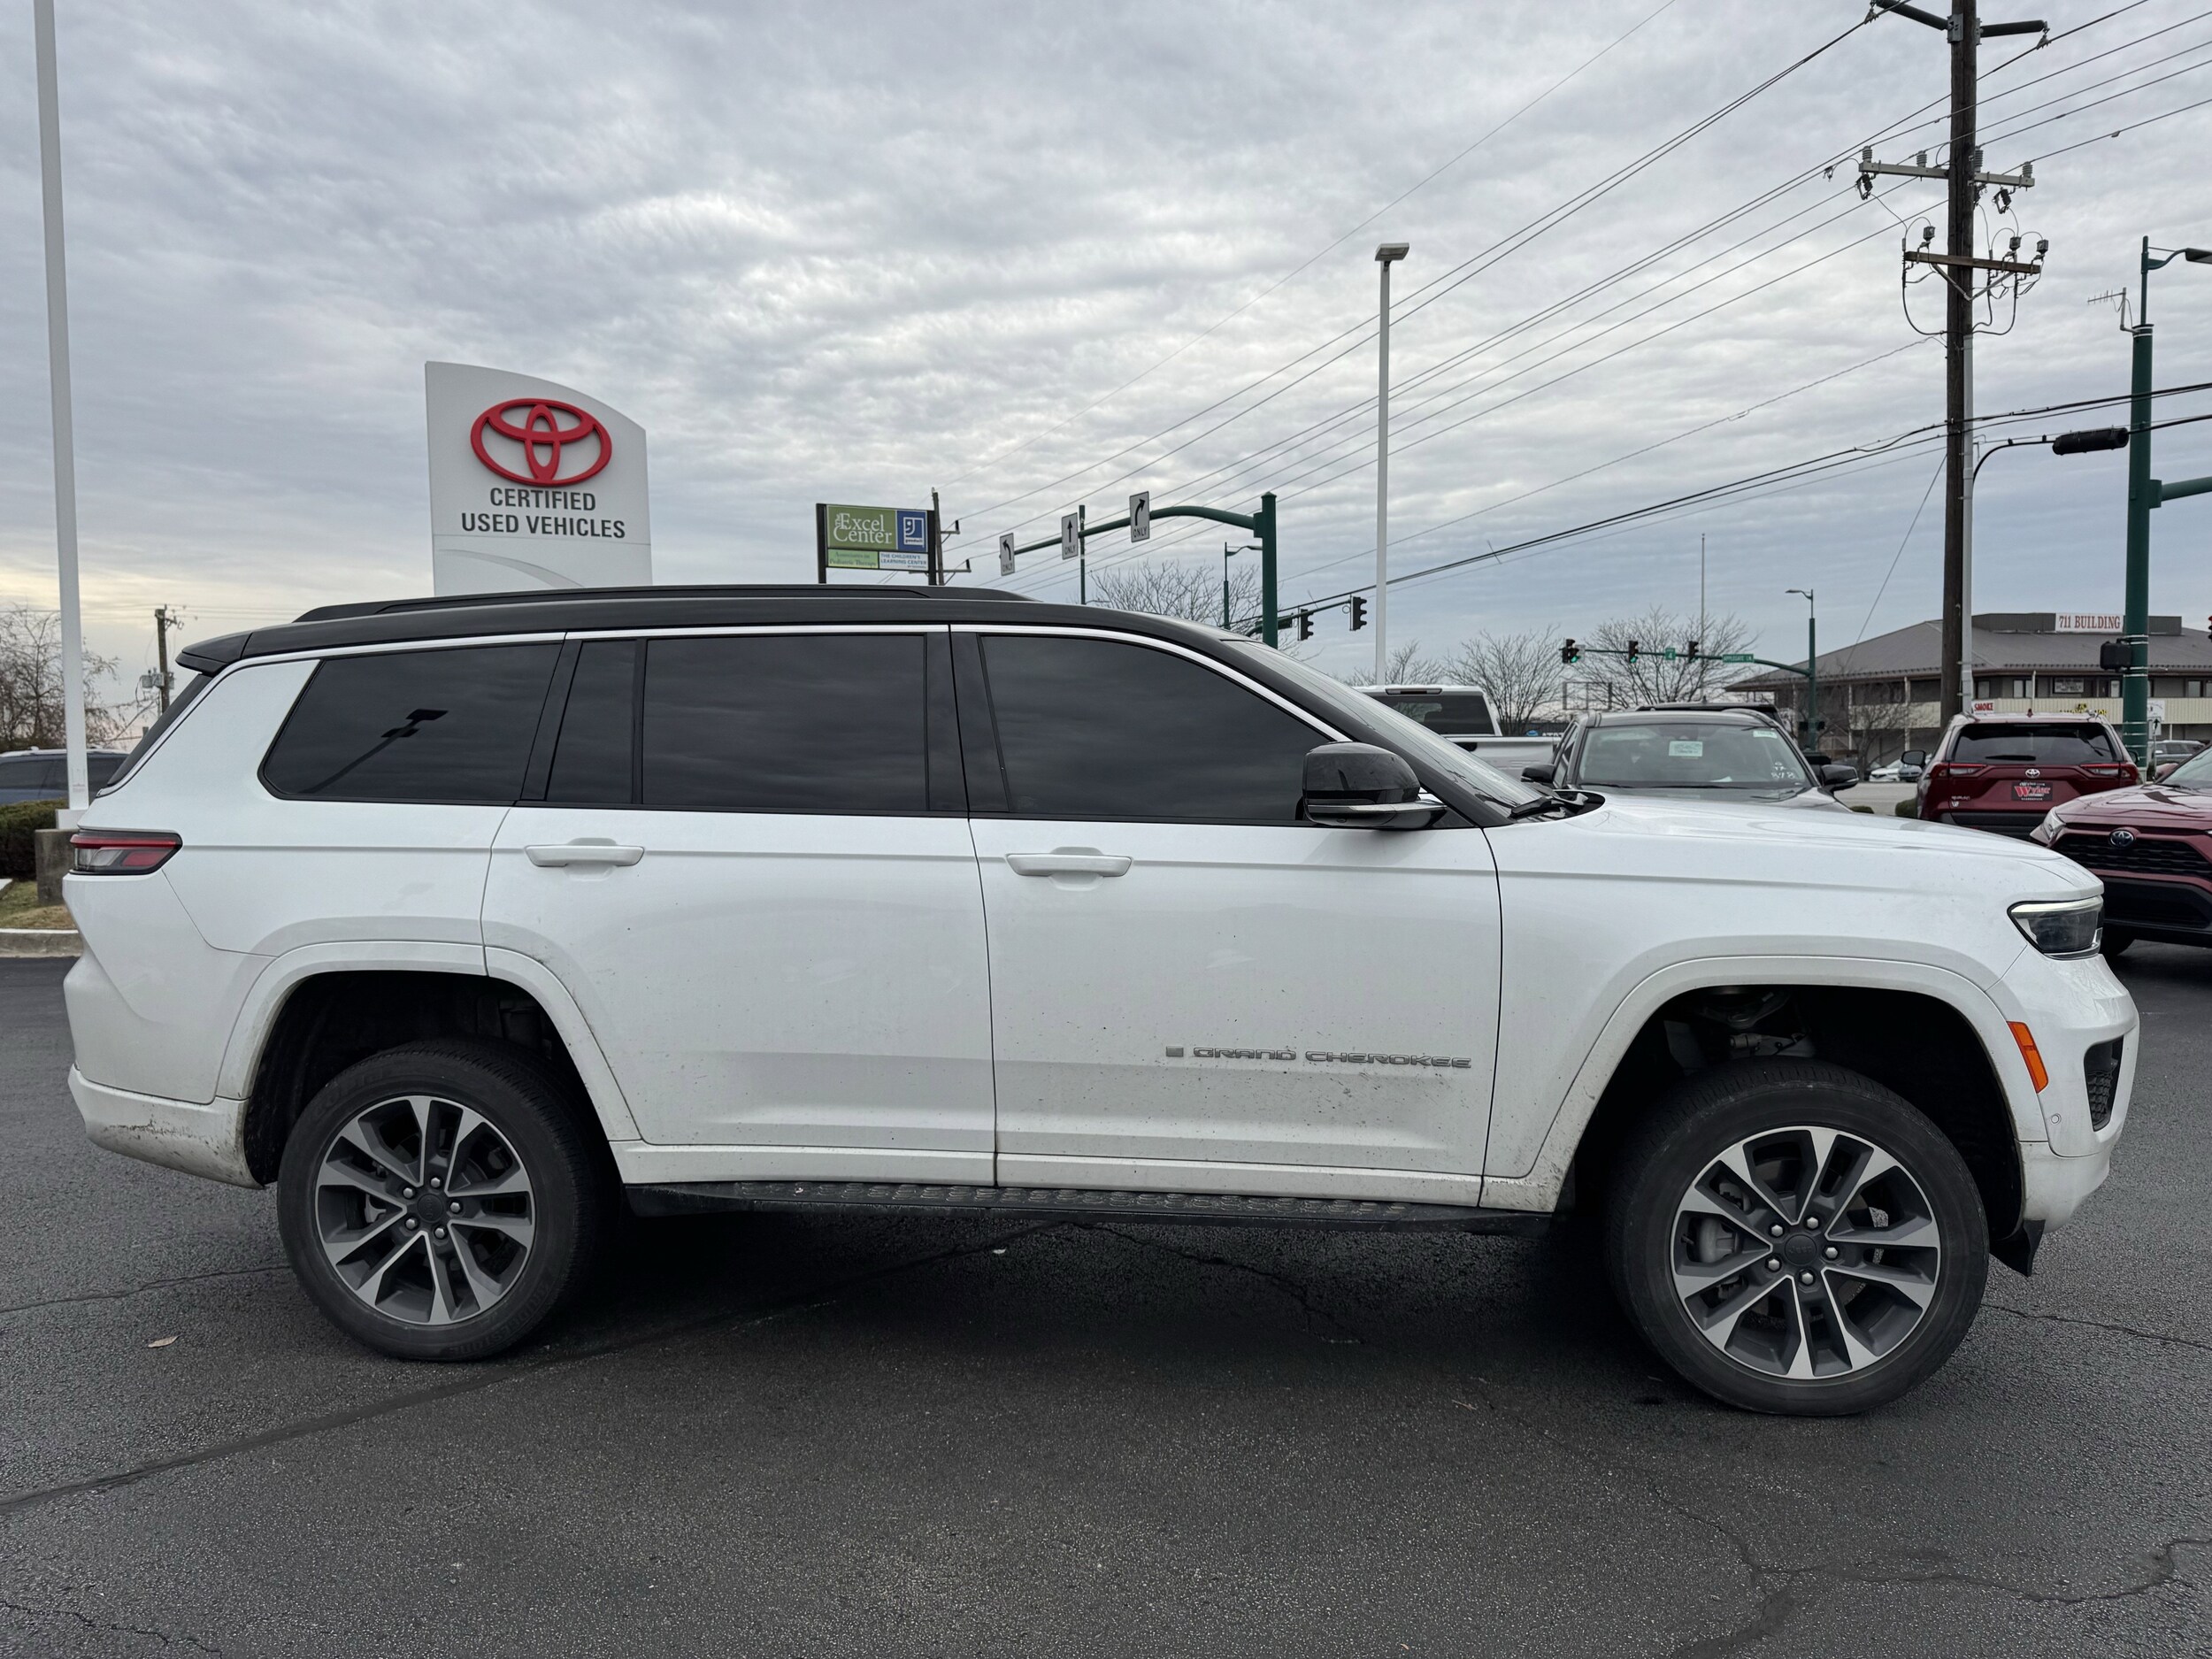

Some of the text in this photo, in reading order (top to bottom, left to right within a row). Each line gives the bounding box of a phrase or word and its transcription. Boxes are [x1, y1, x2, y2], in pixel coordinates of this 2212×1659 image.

[490, 488, 596, 511] CERTIFIED
[461, 512, 626, 539] USED VEHICLES
[839, 512, 885, 532] Excel
[833, 525, 893, 544] Center
[1133, 526, 1147, 538] ONLY
[1064, 544, 1076, 556] ONLY
[2059, 615, 2121, 629] 711 BUILDING
[1974, 703, 1993, 711] SMOKE
[1194, 1047, 1471, 1069] GRAND CHEROKEE
